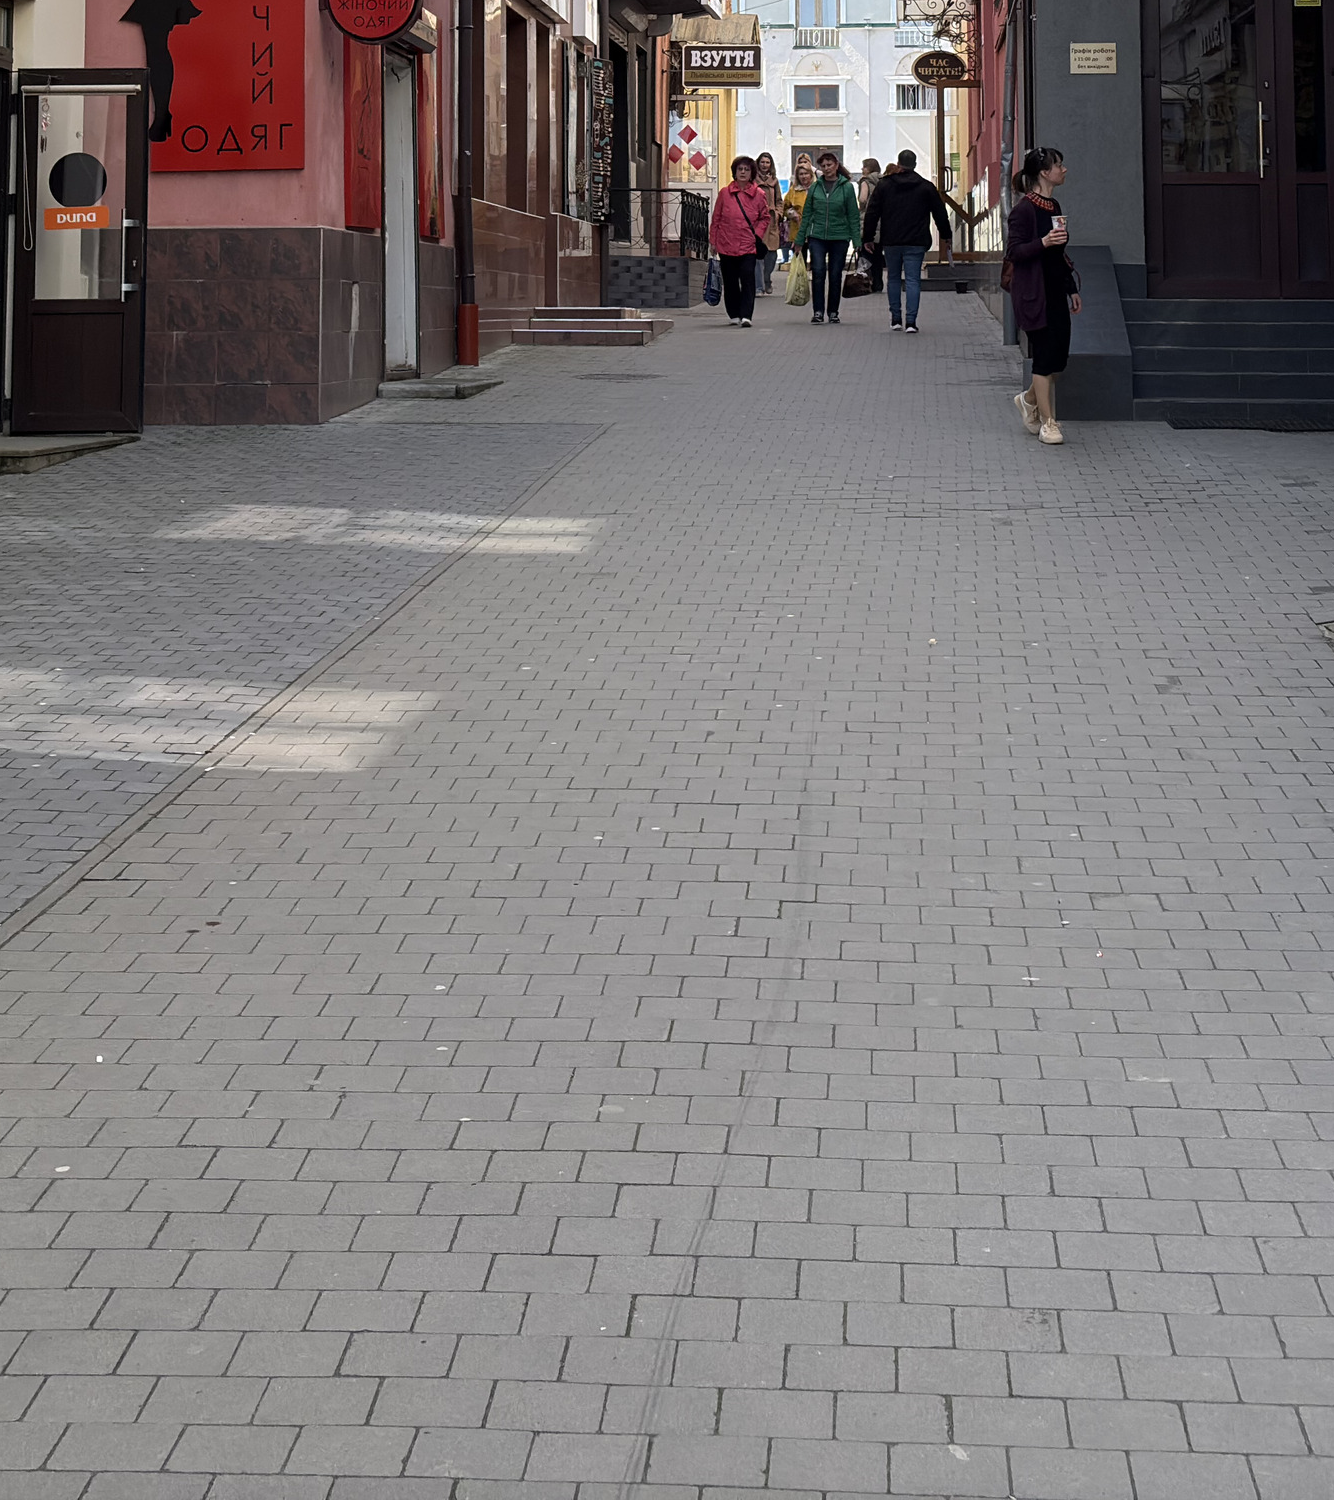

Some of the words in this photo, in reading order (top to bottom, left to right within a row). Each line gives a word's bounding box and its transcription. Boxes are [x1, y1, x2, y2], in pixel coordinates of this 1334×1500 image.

[353, 14, 394, 30] ОДЯГ
[690, 50, 755, 67] ВЗУТТЯ
[180, 122, 294, 156] ОДЯГ
